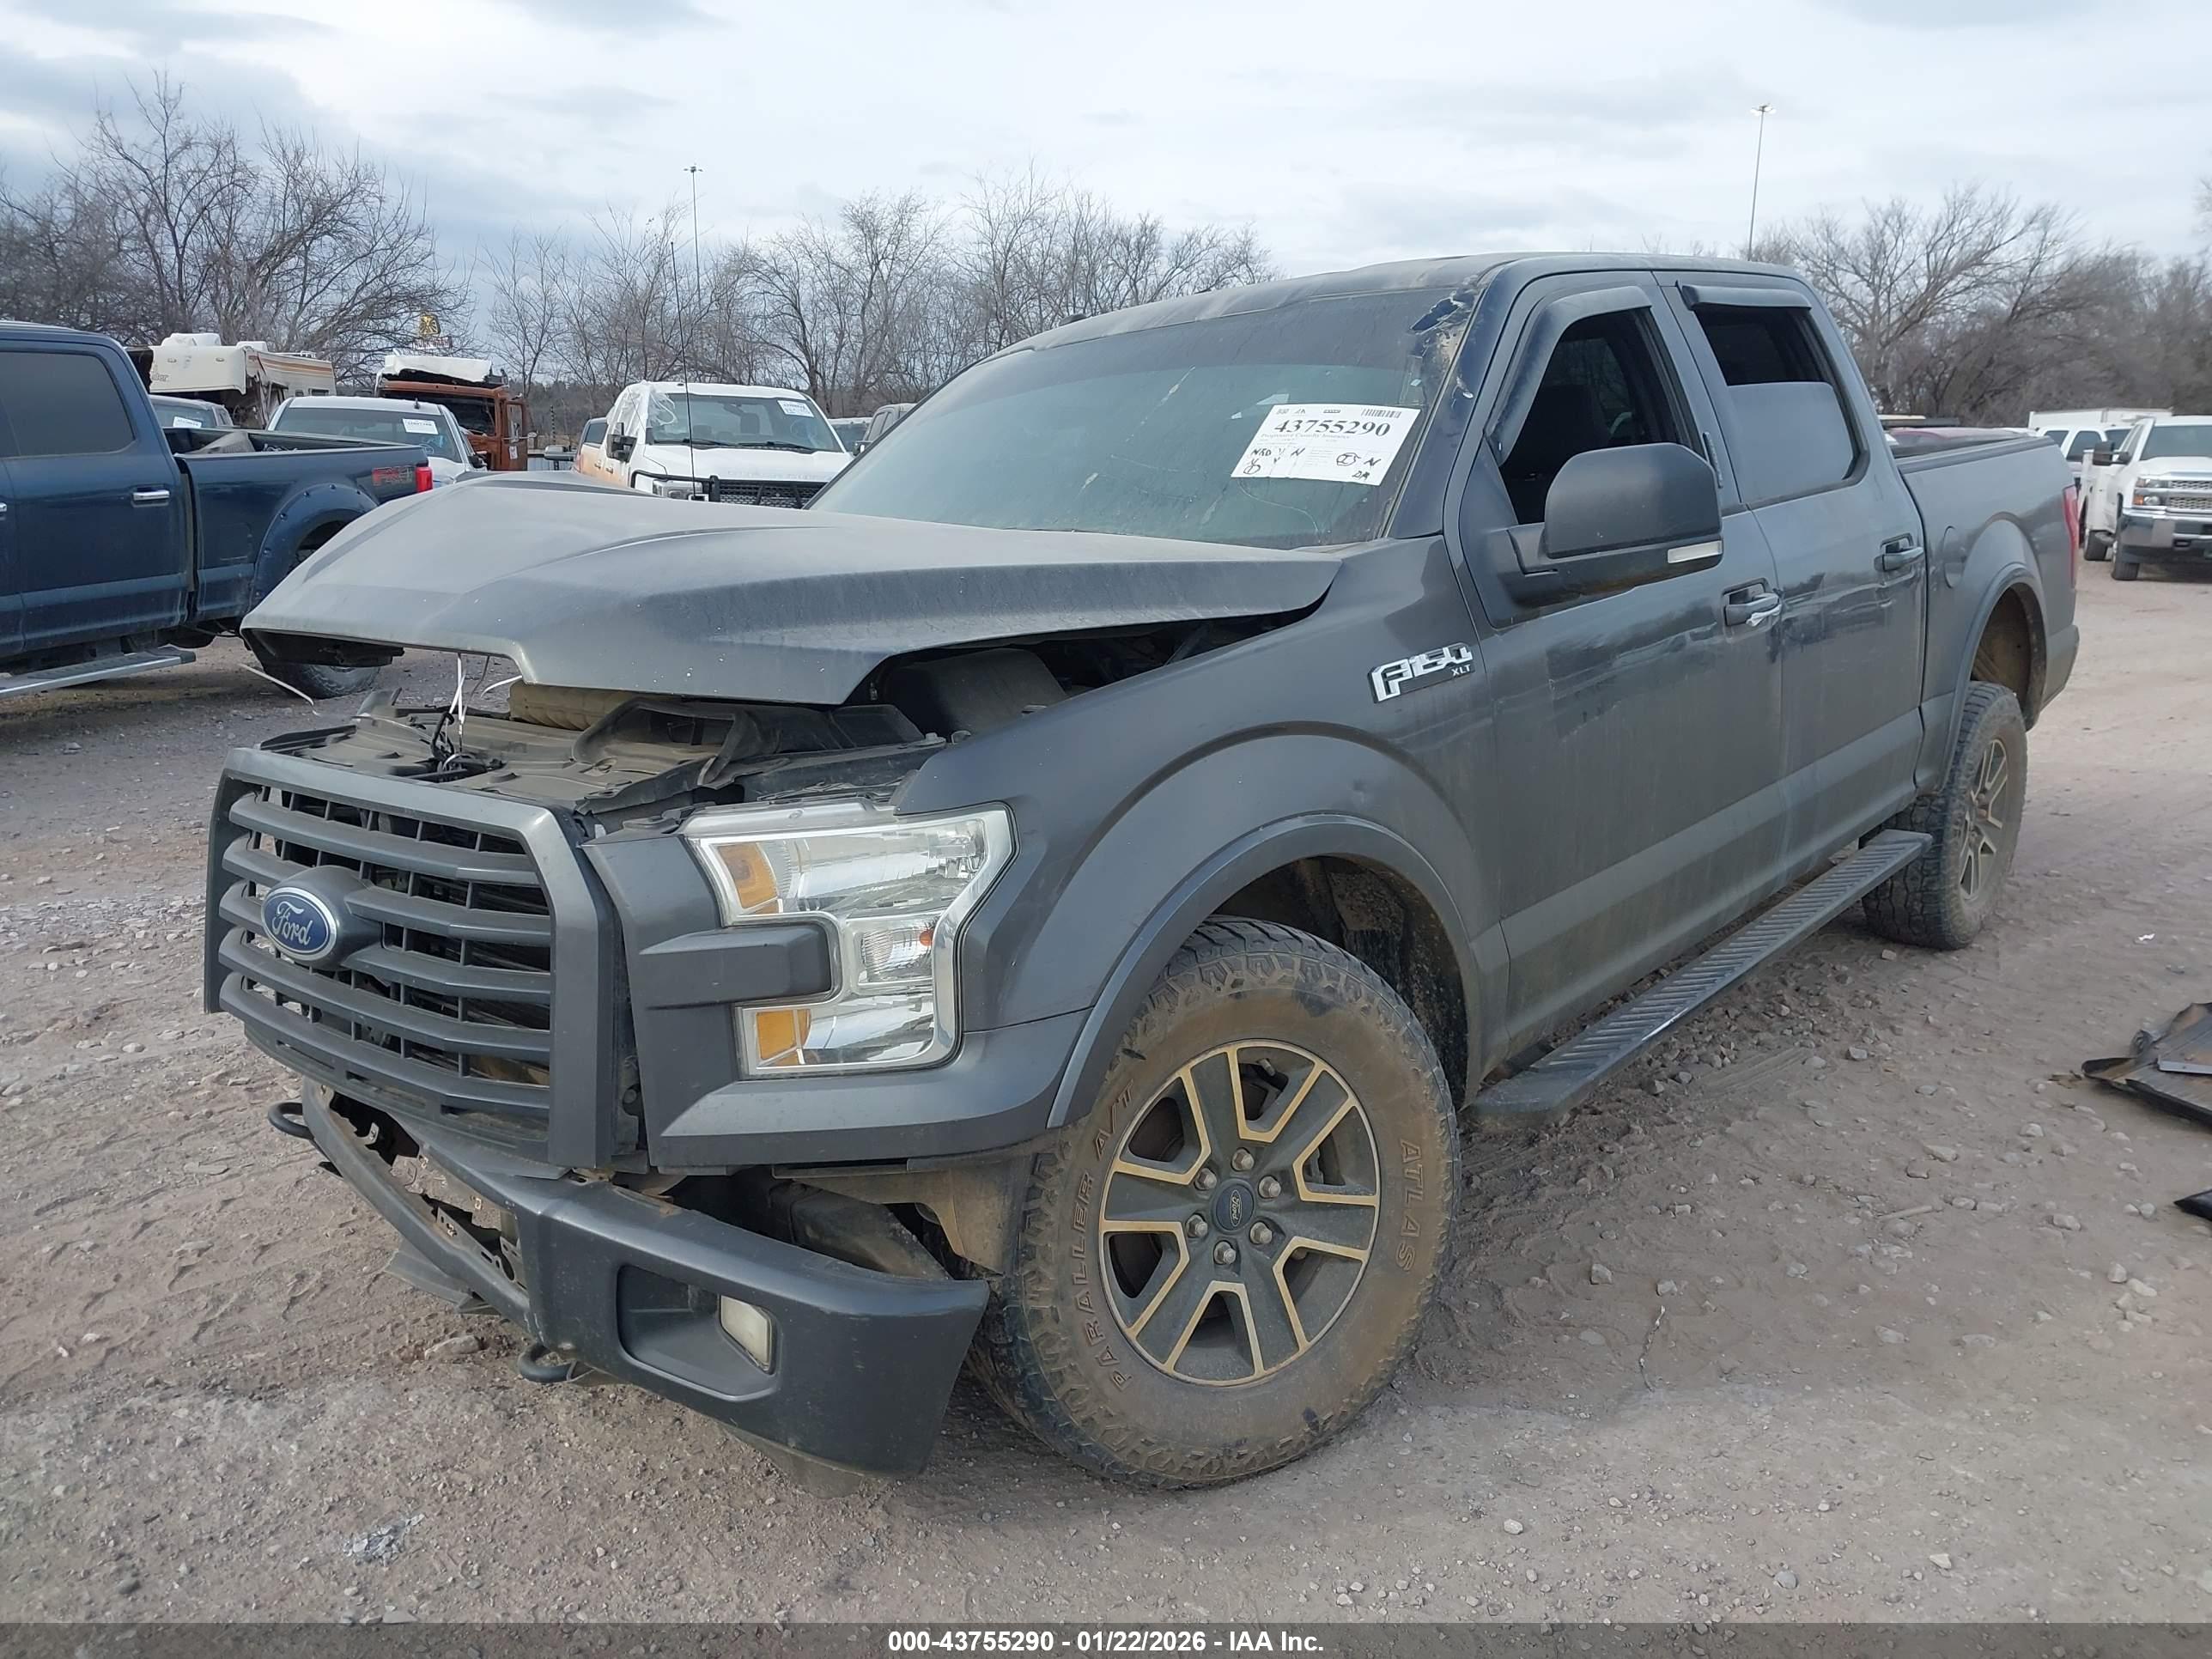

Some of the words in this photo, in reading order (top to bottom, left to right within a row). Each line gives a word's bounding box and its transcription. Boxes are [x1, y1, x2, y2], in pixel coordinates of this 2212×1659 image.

[1273, 419, 1391, 437] 43755290
[1451, 664, 1471, 677] XLT
[271, 901, 313, 945] Ford
[1395, 1138, 1425, 1273] ATLAS
